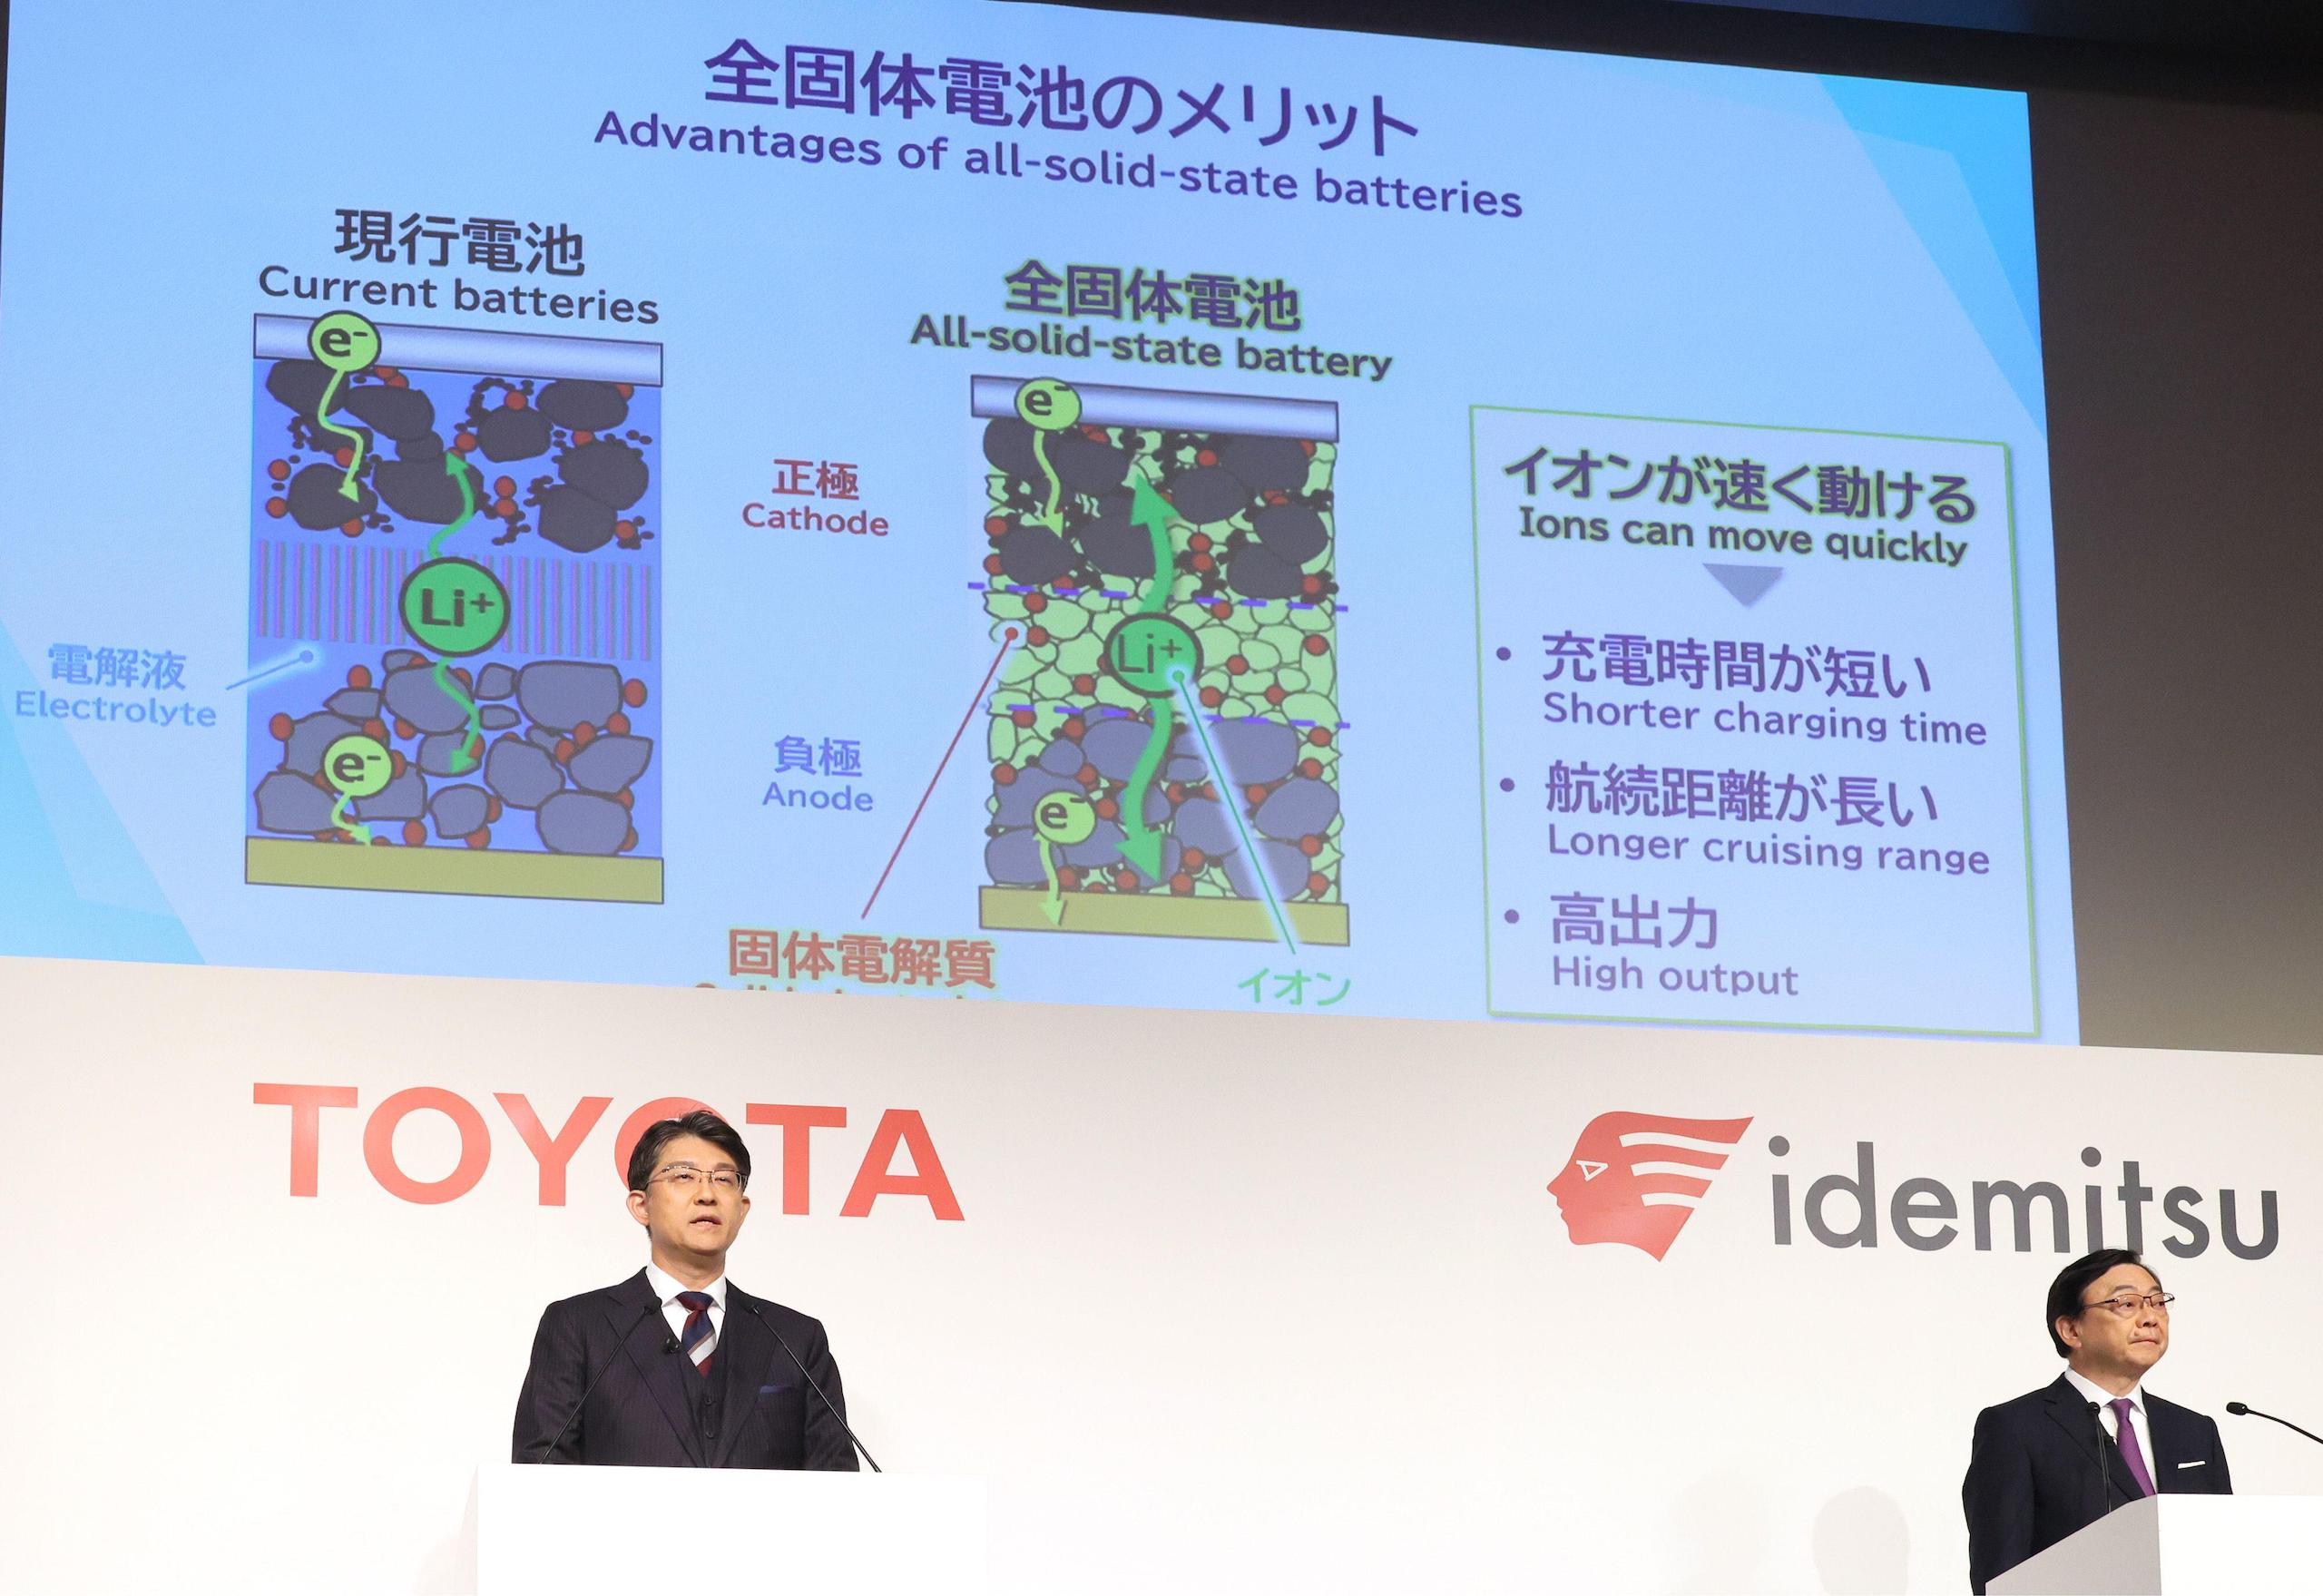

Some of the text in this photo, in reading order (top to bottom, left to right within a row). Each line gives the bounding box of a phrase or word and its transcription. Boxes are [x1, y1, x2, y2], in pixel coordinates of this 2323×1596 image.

[704, 37, 1419, 157] 全固体電池のメリット
[594, 111, 1523, 219] Advantages of all-solid-state batteries
[333, 209, 585, 276] 現行電池
[259, 265, 660, 325] Current batteries
[1004, 259, 1303, 333] 全固体電池
[910, 314, 1393, 383] All-solid-state battery
[771, 458, 860, 502] 正極
[1504, 446, 1976, 524] イオンが速く動ける
[741, 502, 889, 538] Cathode
[1519, 505, 1968, 566] Ions can move quickly
[47, 642, 187, 691] 電解液
[1543, 630, 1931, 700] 充電時間が短い
[15, 690, 217, 729] Electrolyte
[1544, 691, 1987, 746] Shorter charging time
[774, 735, 863, 779] 負極
[762, 781, 874, 814] Anode
[1545, 759, 1939, 827] 航続距離が長い
[1549, 823, 1990, 876] Longer cruising range
[1551, 891, 1718, 950] 高出力
[728, 929, 997, 991] 固体電解質
[1238, 967, 1351, 1007] イオン
[1552, 955, 1799, 996] High output
[1768, 1135, 2279, 1261] idemitsu
